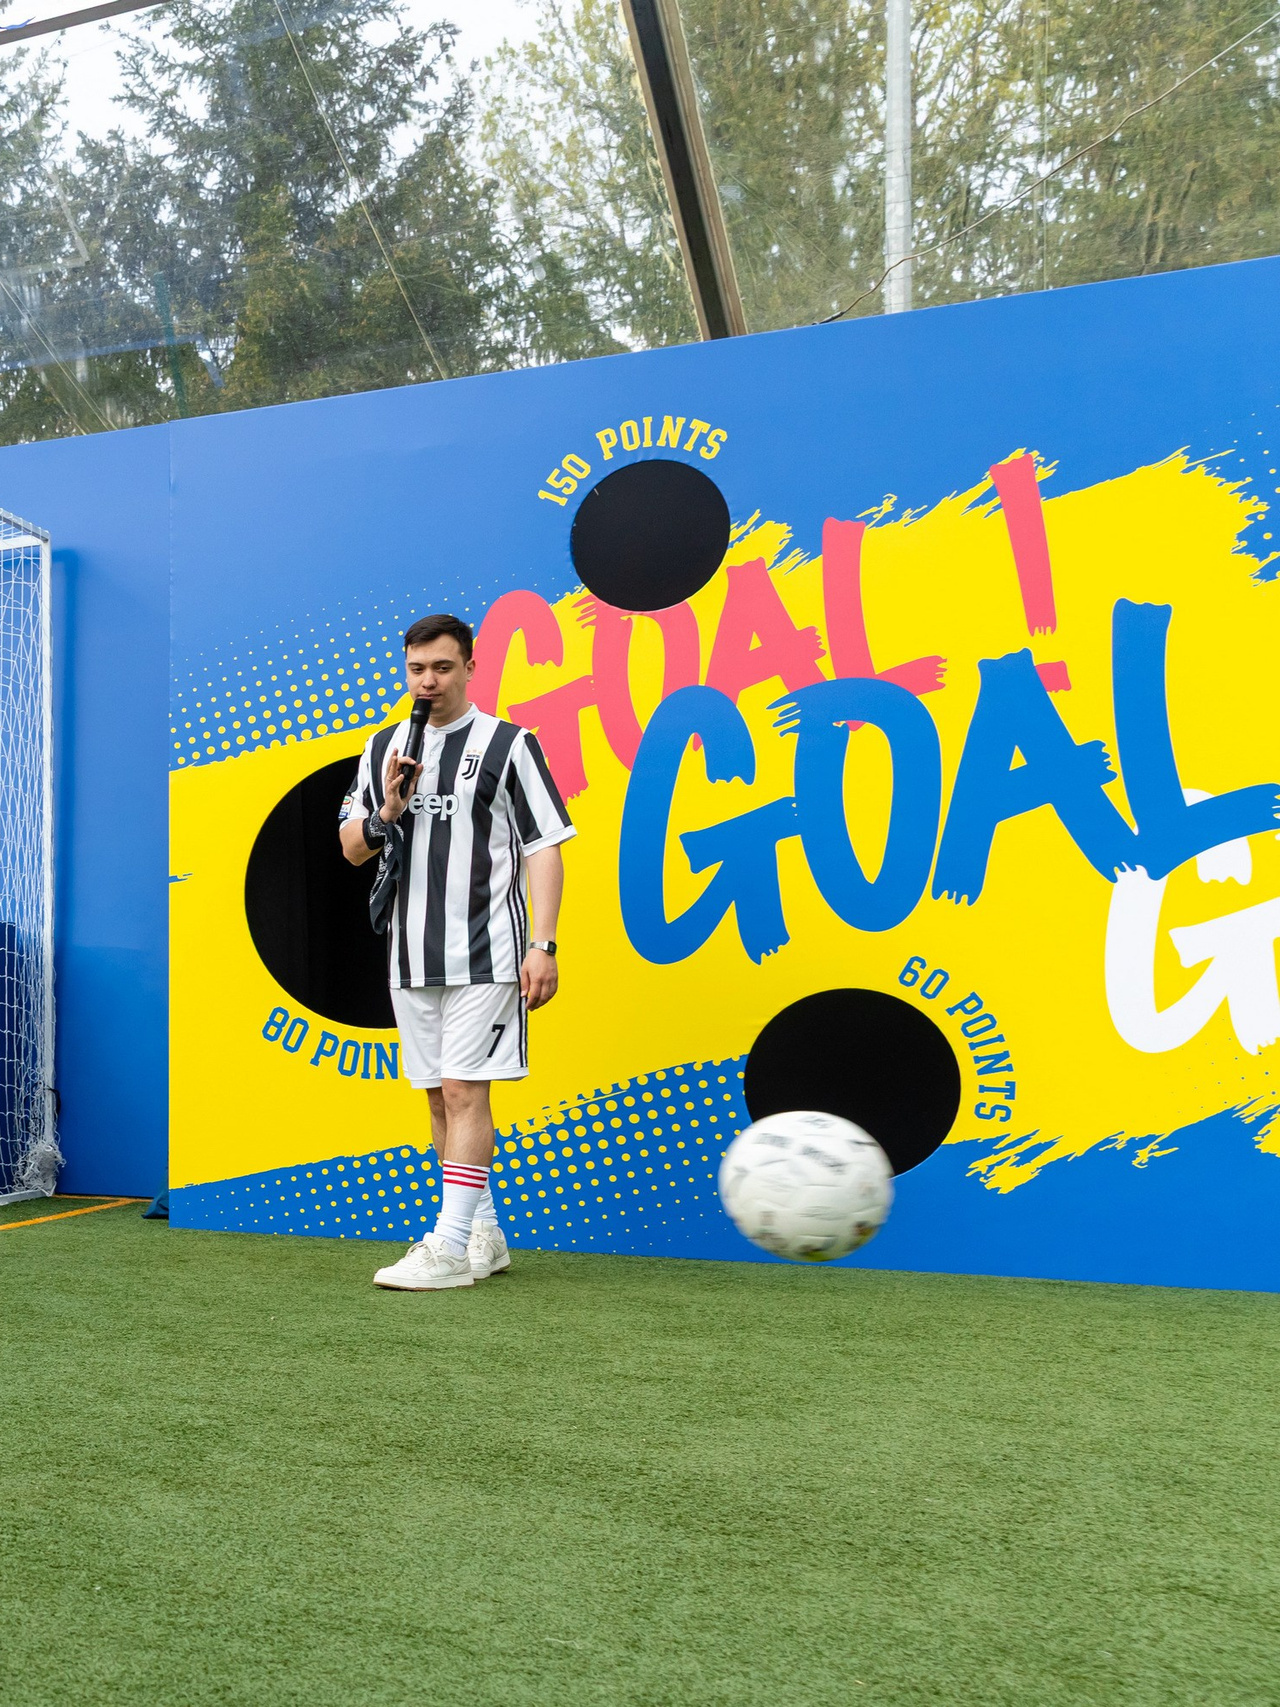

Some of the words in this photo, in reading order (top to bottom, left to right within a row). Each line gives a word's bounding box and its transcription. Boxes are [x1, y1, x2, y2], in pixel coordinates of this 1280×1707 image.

[537, 453, 591, 507] 150
[595, 415, 728, 460] POINTS
[402, 793, 460, 821] eep
[619, 598, 1280, 965] GOAL
[262, 1006, 310, 1053] 80
[310, 1030, 399, 1080] POIN
[486, 1024, 506, 1058] 7
[898, 956, 950, 1000] 60
[945, 991, 1016, 1122] POINTS
